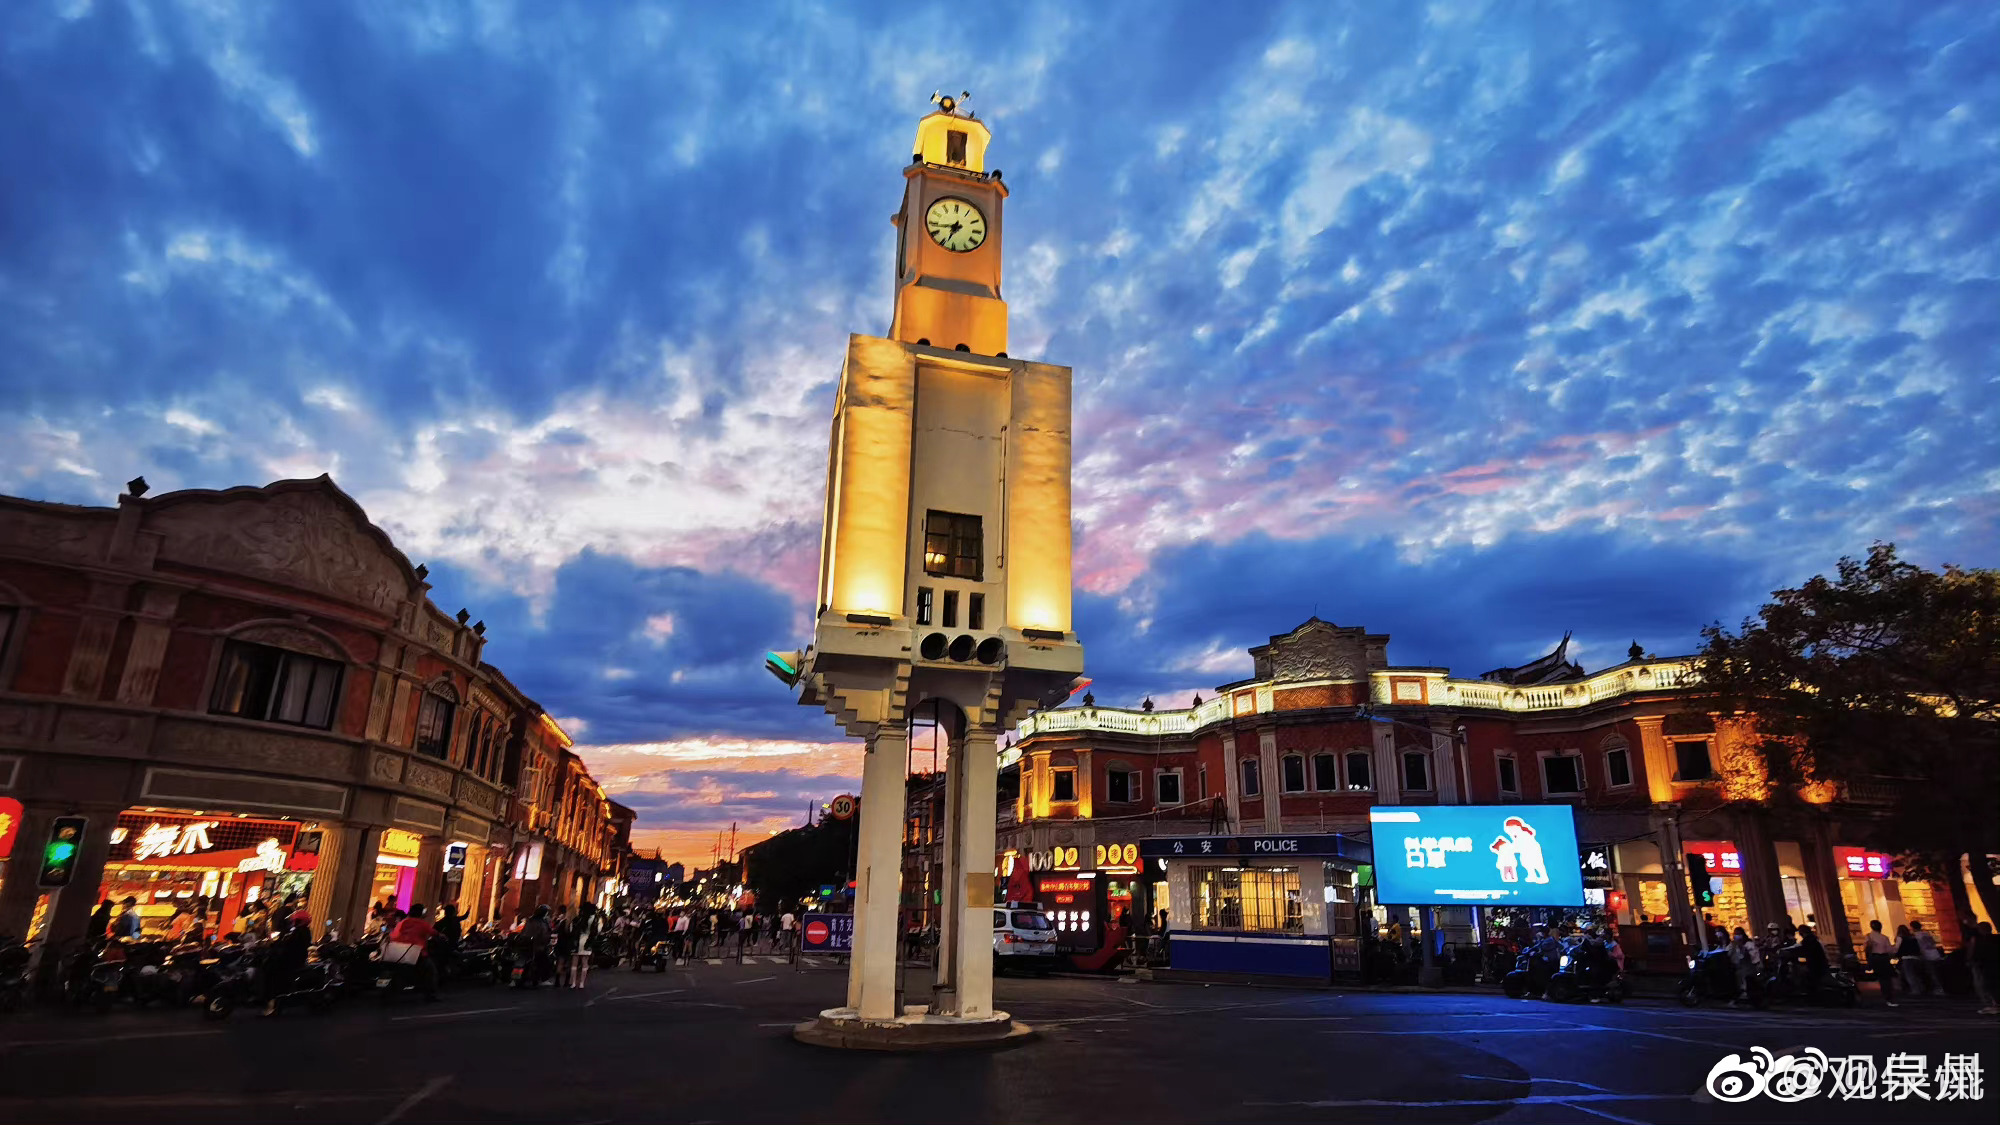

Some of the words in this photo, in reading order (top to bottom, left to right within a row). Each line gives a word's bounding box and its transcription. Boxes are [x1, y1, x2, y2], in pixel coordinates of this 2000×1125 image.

[836, 801, 850, 813] 30
[1173, 840, 1213, 853] 公安
[1254, 840, 1298, 852] POLICE
